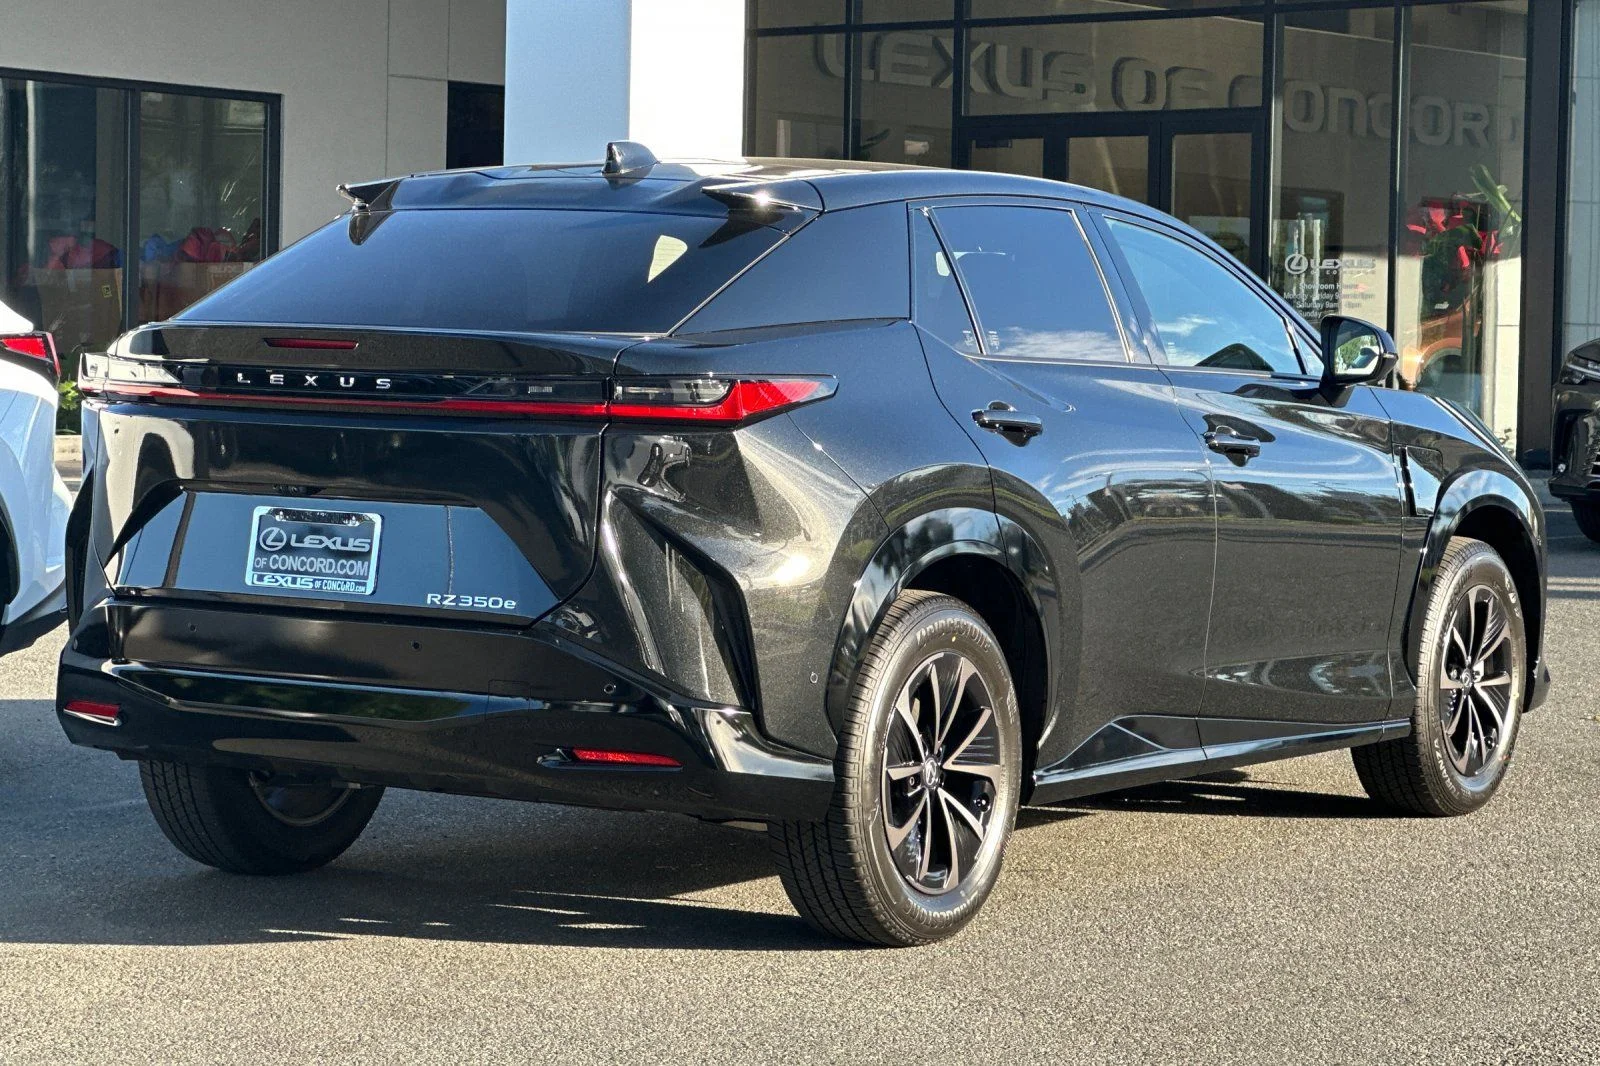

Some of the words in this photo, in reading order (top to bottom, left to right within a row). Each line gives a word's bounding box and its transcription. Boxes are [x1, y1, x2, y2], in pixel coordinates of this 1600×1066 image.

[815, 32, 1097, 103] LEXUS
[237, 372, 391, 389] LEXUS
[290, 533, 371, 552] LEXUS
[254, 557, 268, 569] OF
[269, 554, 369, 576] CONCORD.COM
[252, 573, 314, 589] LEXUS
[314, 580, 322, 589] OF
